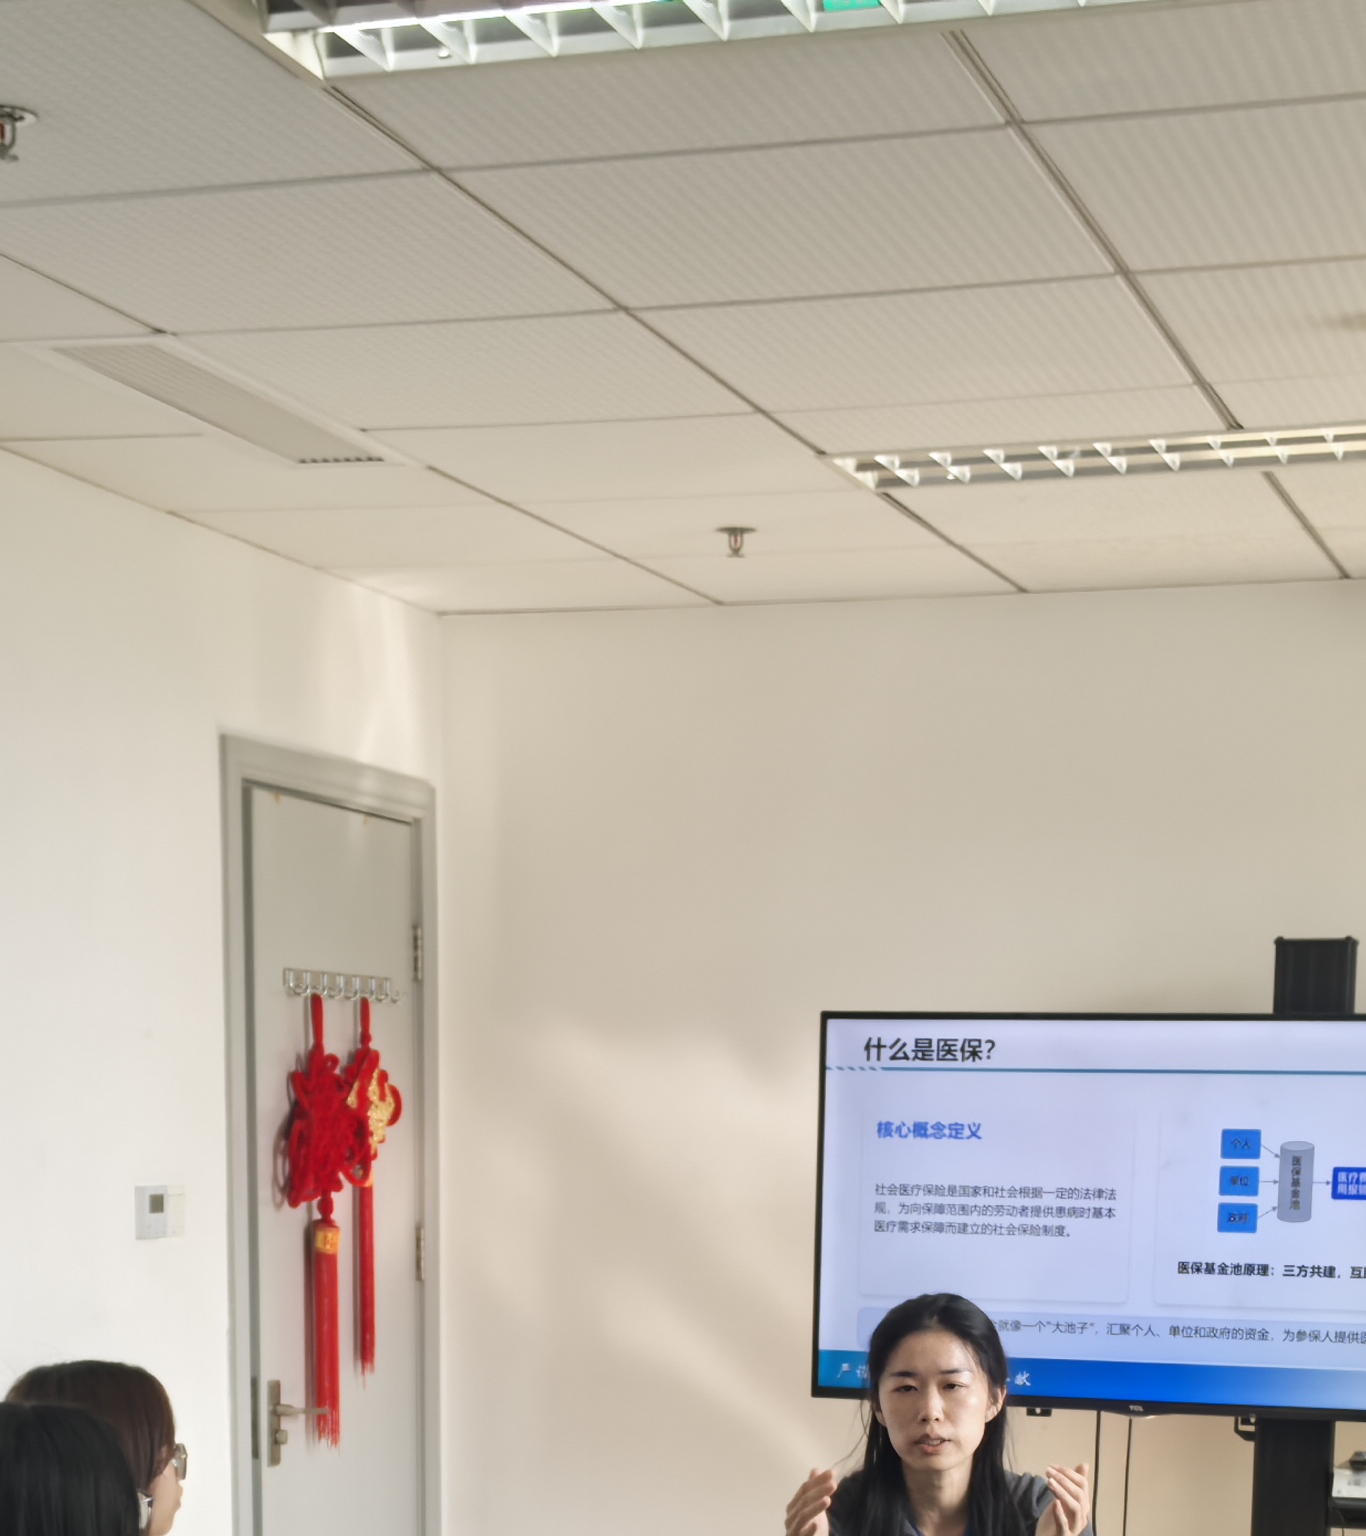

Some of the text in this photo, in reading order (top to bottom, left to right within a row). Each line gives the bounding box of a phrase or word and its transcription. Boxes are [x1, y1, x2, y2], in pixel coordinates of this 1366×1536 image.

[863, 1037, 996, 1062] 什么是医保?
[876, 1121, 982, 1140] 核心概念定义
[1231, 1138, 1251, 1150] 个人
[874, 1183, 1117, 1201] 社会医疗保险是国家和社会根据一定的法律法
